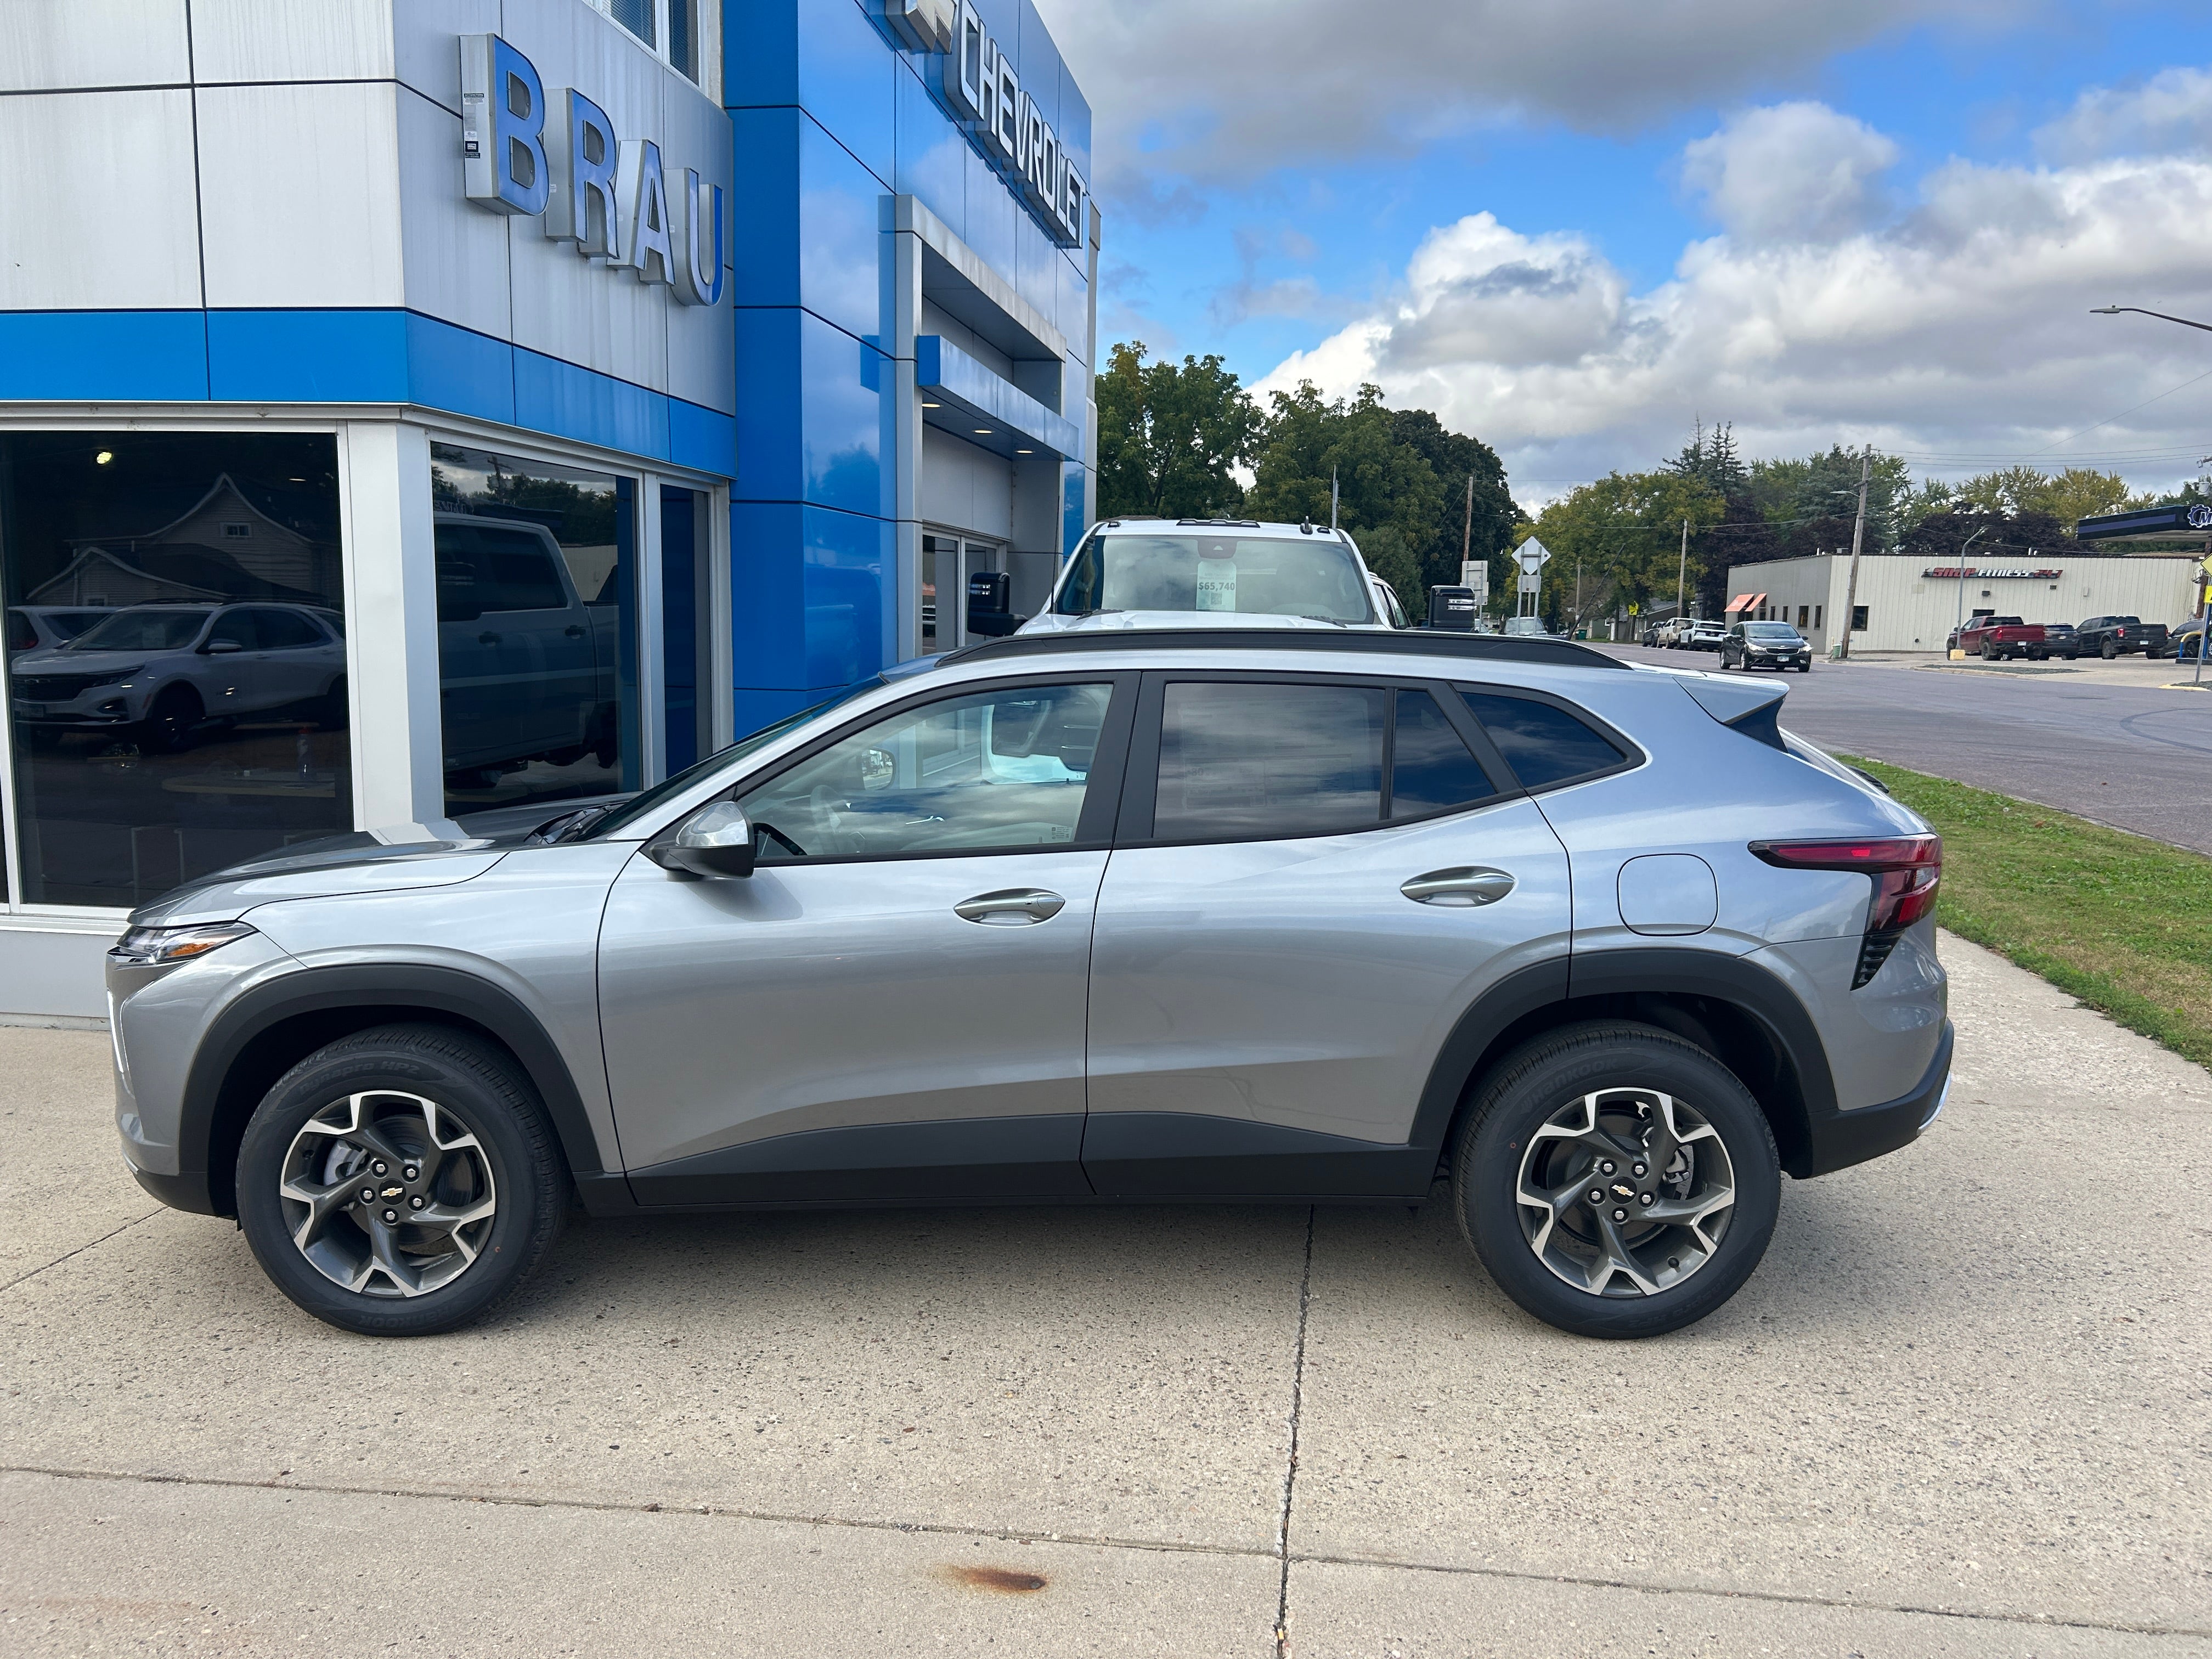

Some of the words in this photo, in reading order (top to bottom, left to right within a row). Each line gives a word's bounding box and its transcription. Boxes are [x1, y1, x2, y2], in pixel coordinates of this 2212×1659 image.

[959, 0, 1087, 249] CHEVROLET
[489, 33, 723, 306] BRAU
[1978, 569, 2029, 577] FITNESS
[1198, 582, 1235, 591] $65,740
[380, 1060, 421, 1075] HP2
